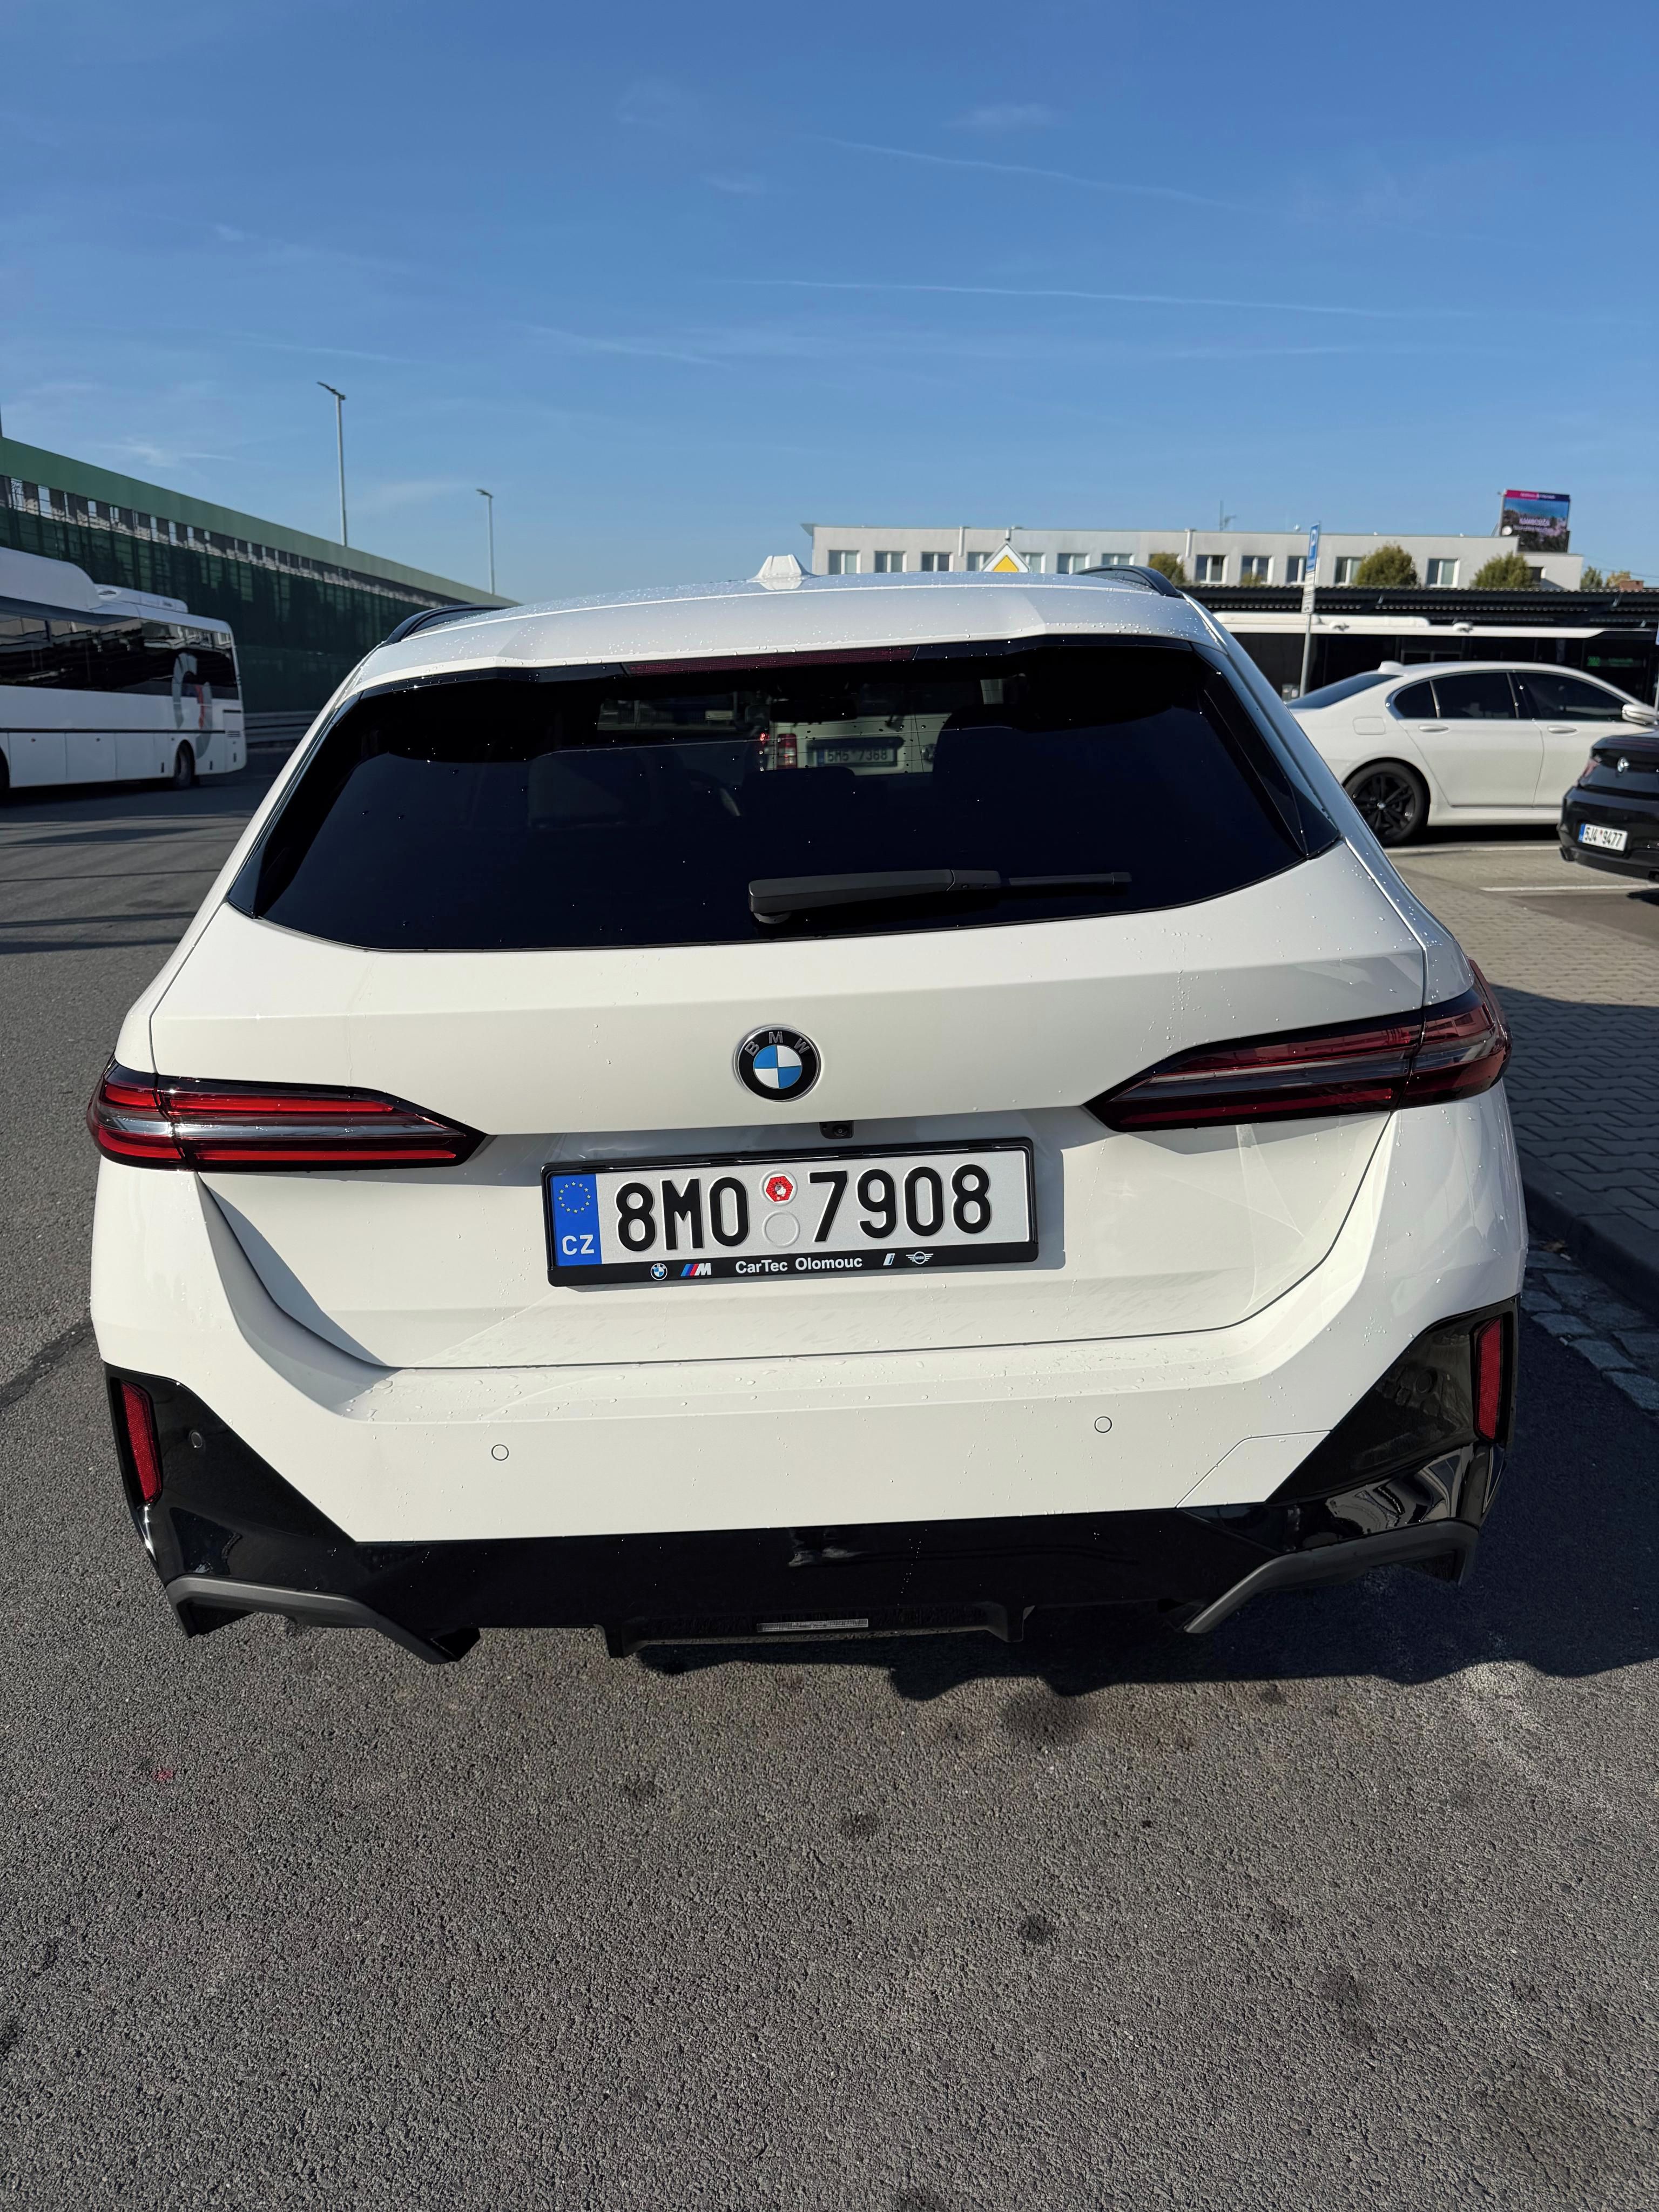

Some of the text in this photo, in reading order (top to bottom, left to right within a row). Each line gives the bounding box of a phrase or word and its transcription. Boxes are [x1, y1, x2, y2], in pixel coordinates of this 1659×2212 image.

[828, 748, 887, 762] 5M5 7368
[1584, 827, 1623, 847] 5J4 9477
[744, 1031, 811, 1056] BMW
[809, 1164, 993, 1243] 7908
[562, 1234, 595, 1255] CZ
[736, 1257, 862, 1274] CarTec Olomouc
